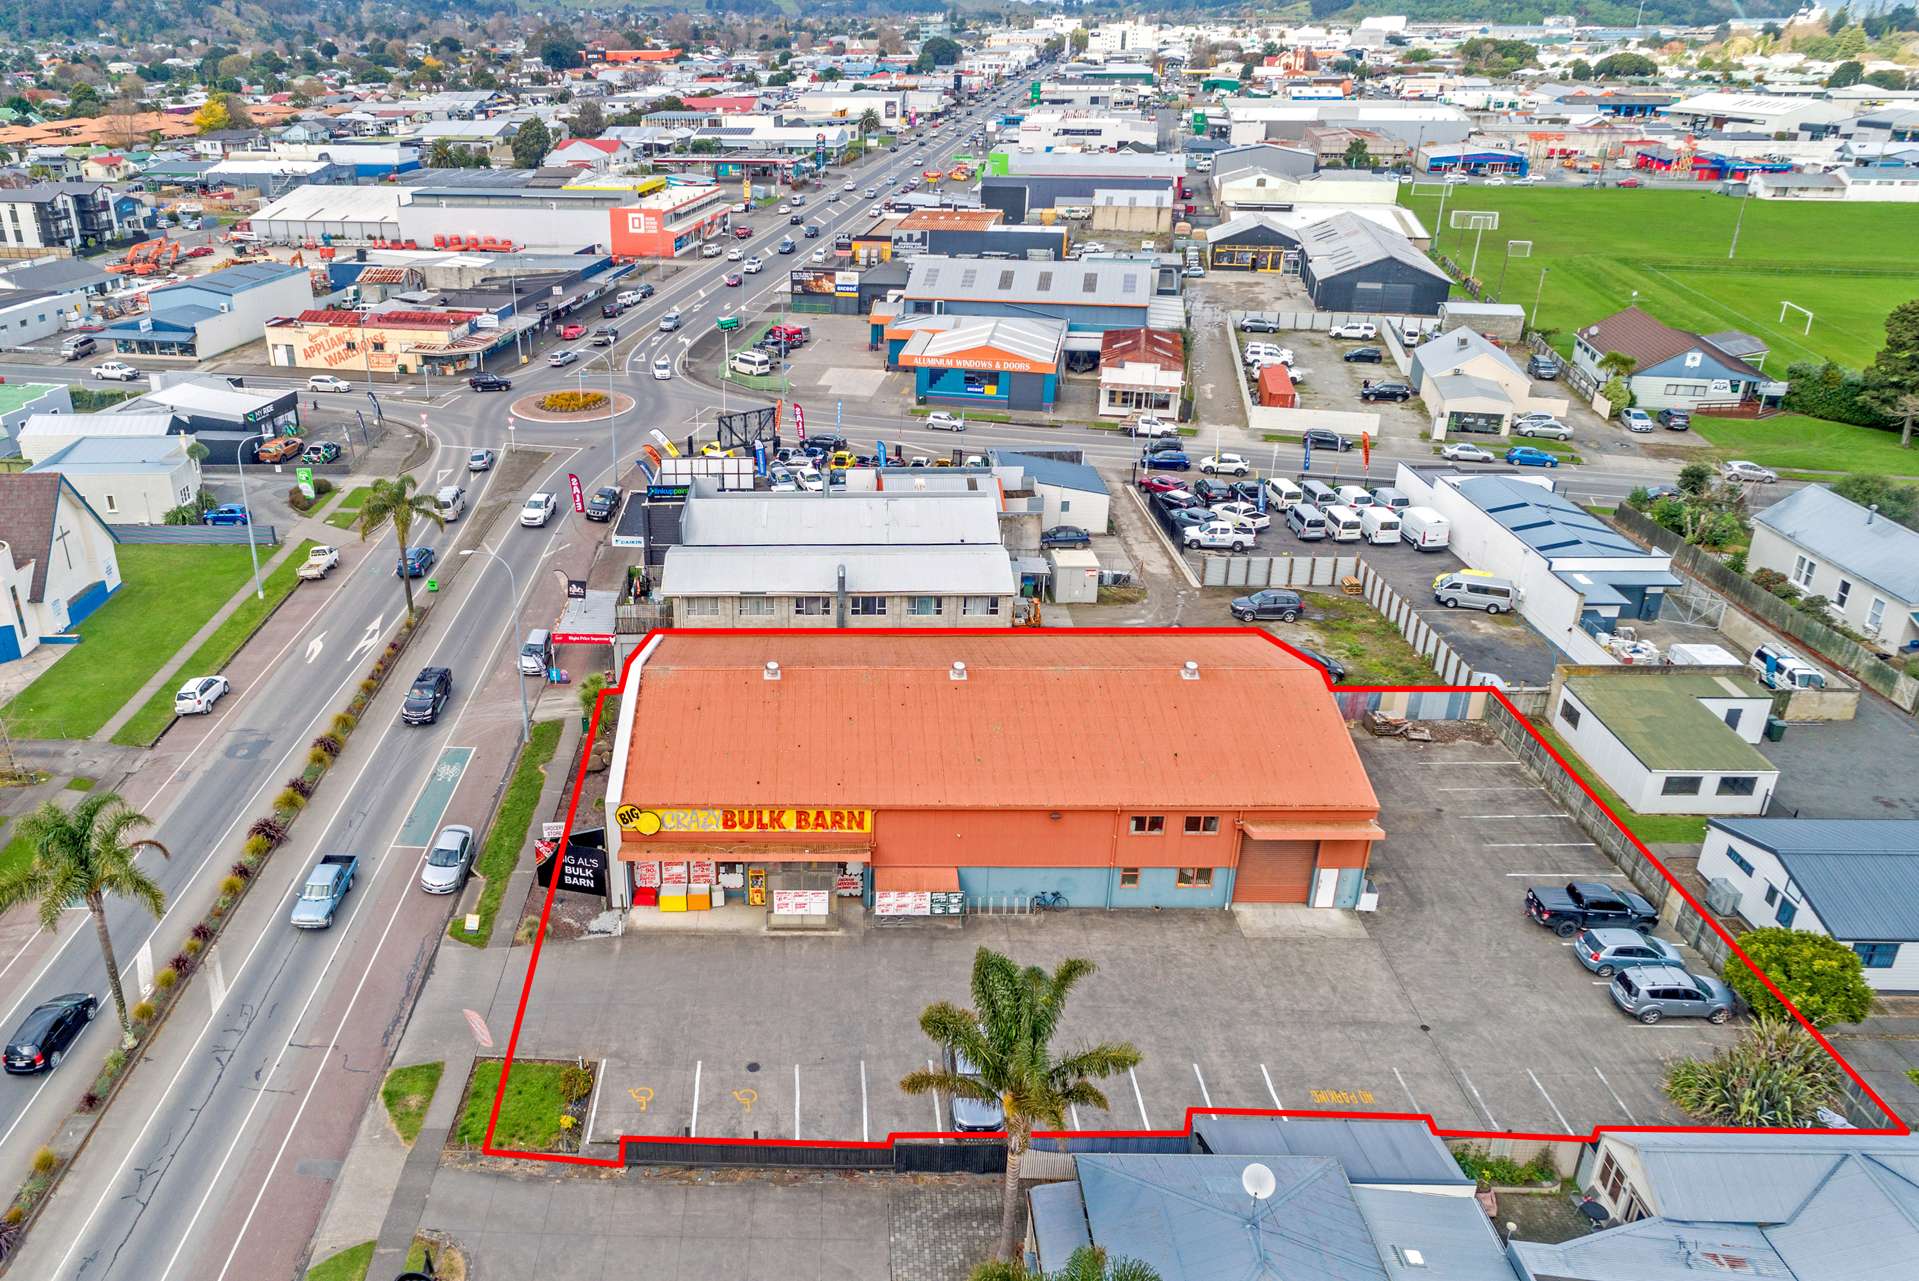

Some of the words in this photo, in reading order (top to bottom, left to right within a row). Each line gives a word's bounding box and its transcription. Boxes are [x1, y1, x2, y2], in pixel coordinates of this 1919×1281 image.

[303, 328, 356, 361] APPLIANCE
[913, 357, 953, 367] ALUMINIUM
[955, 359, 993, 369] WINDOWS
[995, 361, 1001, 369] &
[1003, 362, 1031, 370] DOORS
[618, 807, 641, 826] BIG
[721, 809, 786, 830] BULK
[795, 809, 866, 830] BARN
[577, 857, 599, 868] AL'S
[564, 865, 594, 878] BULK
[564, 876, 595, 888] BARN
